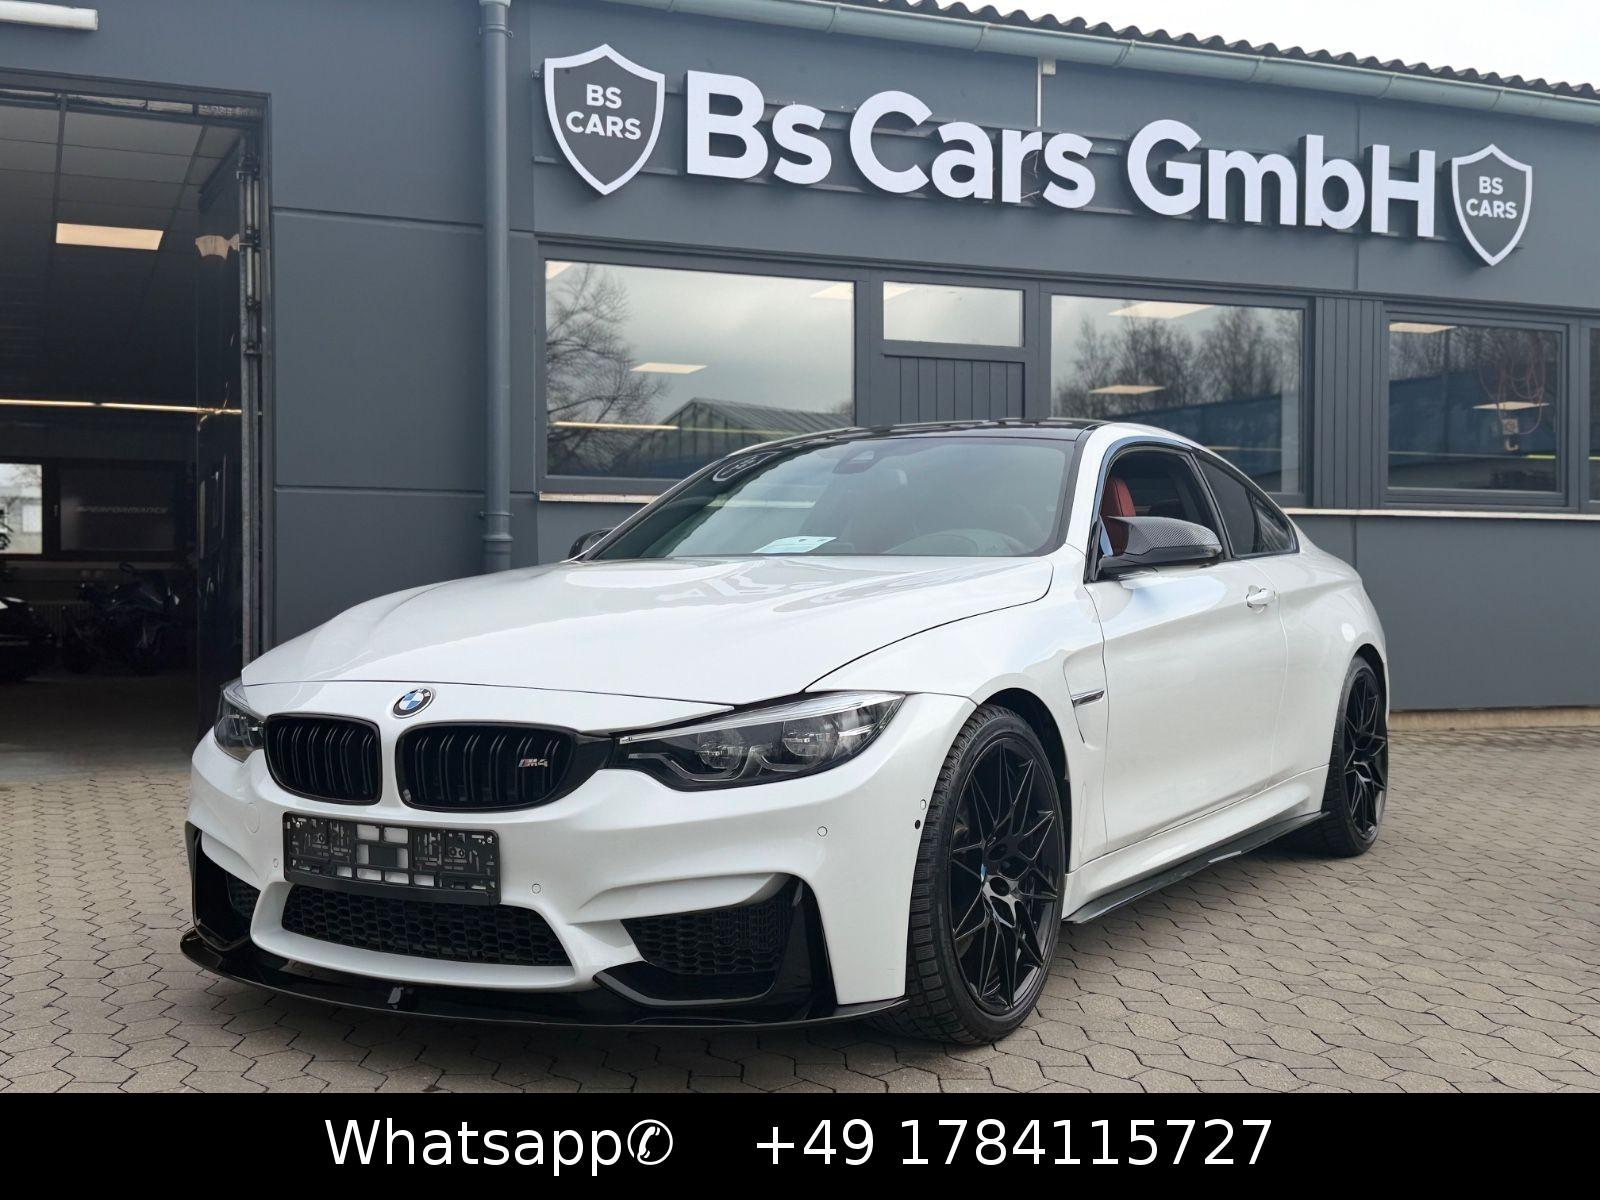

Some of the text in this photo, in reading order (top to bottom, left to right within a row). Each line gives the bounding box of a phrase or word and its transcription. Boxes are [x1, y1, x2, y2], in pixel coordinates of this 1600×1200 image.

[586, 83, 623, 109] BS
[565, 111, 642, 140] CARS
[1127, 119, 1436, 238] GmbH
[1479, 175, 1504, 195] BS
[1466, 198, 1518, 219] CARS
